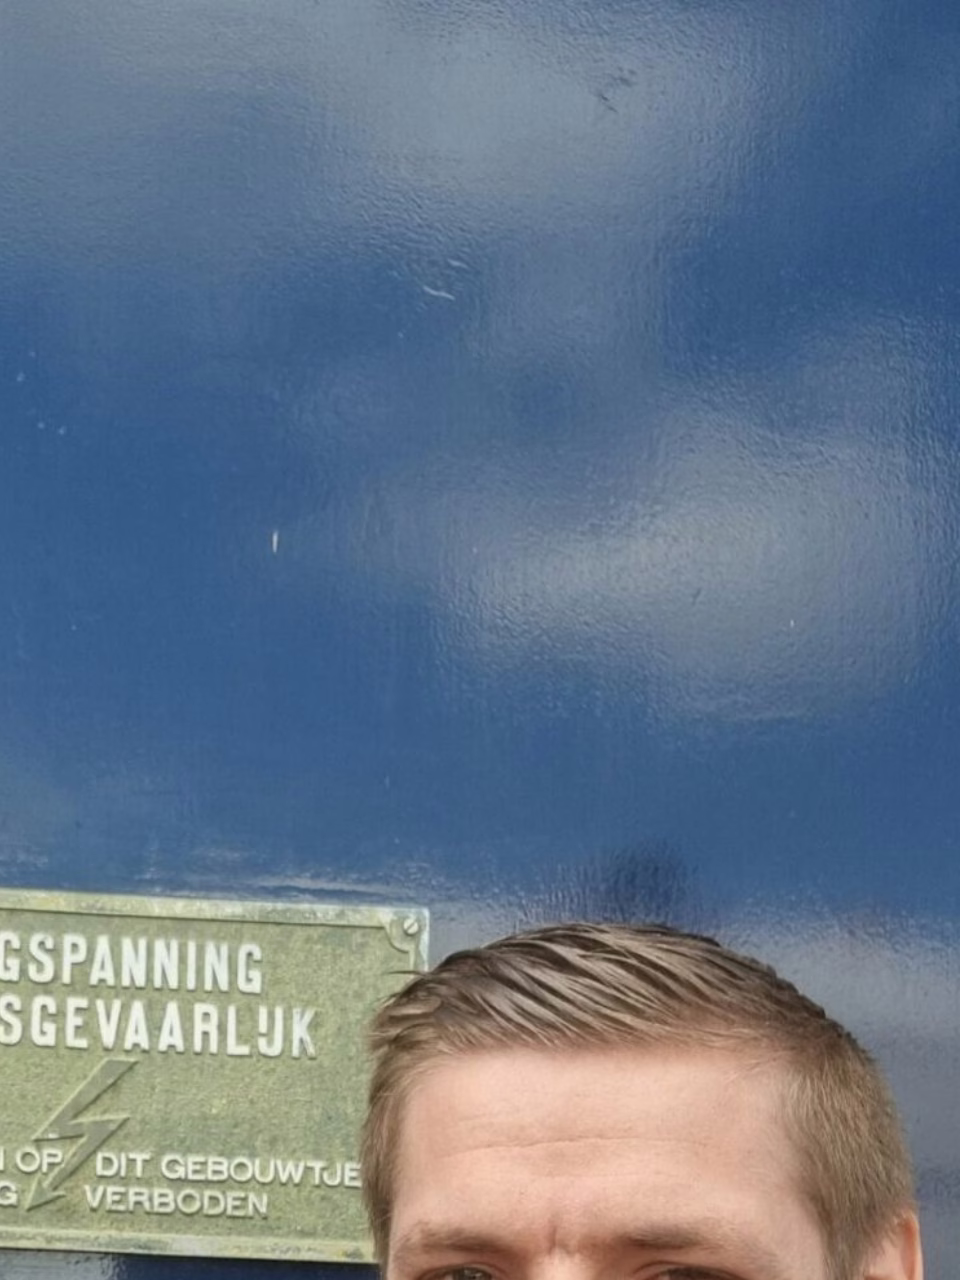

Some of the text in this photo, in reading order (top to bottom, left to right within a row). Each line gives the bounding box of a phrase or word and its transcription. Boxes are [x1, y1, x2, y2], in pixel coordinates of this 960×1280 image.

[15, 1147, 64, 1174] OP
[95, 1151, 152, 1179] DIT
[160, 1153, 363, 1188] GEBOUWTJE
[84, 1184, 269, 1219] VERBODEN
